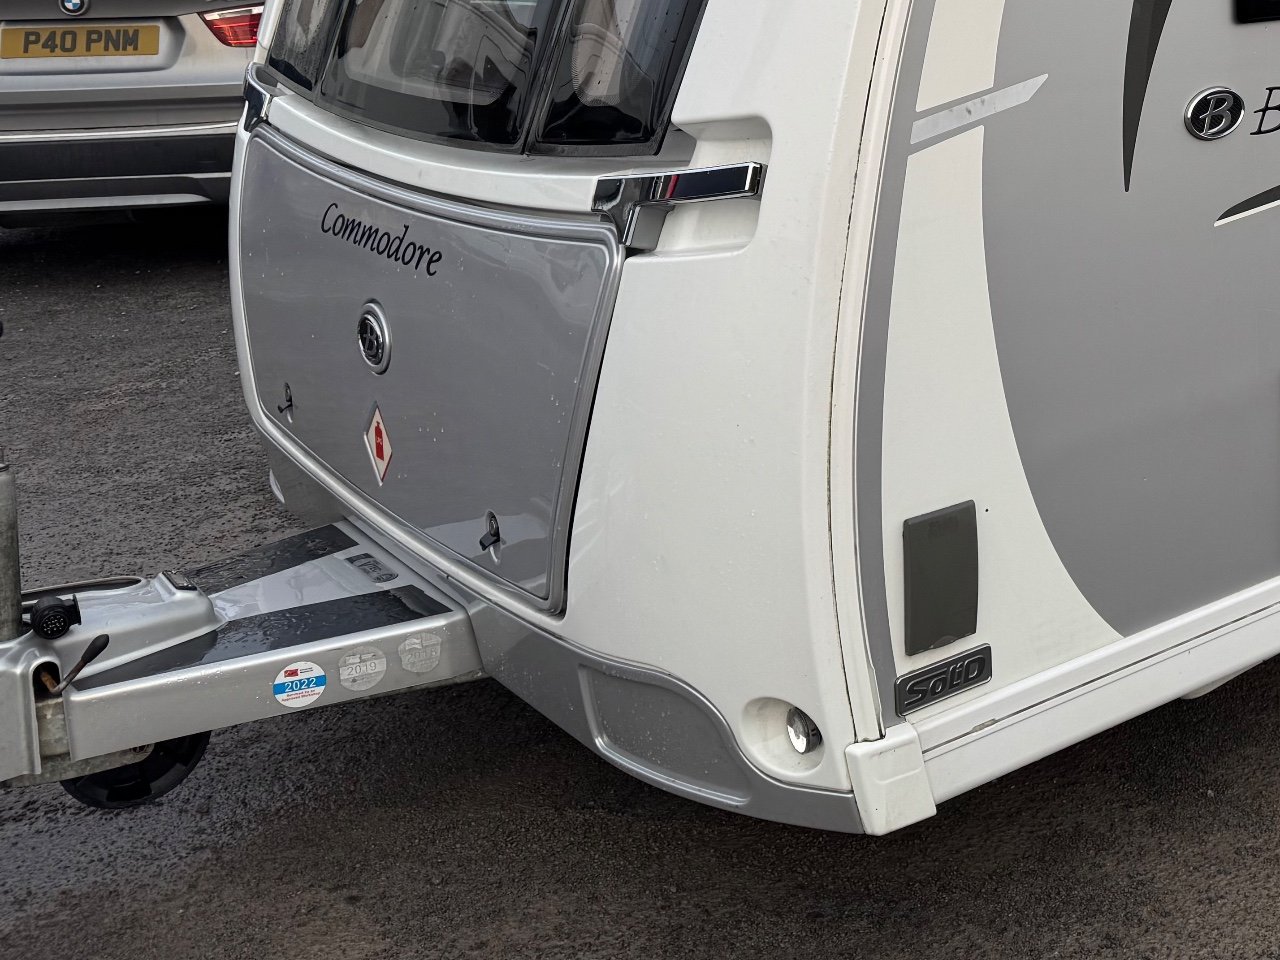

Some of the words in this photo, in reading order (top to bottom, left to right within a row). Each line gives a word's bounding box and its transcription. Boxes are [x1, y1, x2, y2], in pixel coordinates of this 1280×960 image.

[23, 30, 77, 54] P40
[85, 28, 140, 52] PNM
[321, 202, 443, 276] Commodore
[346, 661, 377, 676] 2019
[285, 677, 316, 692] 2022
